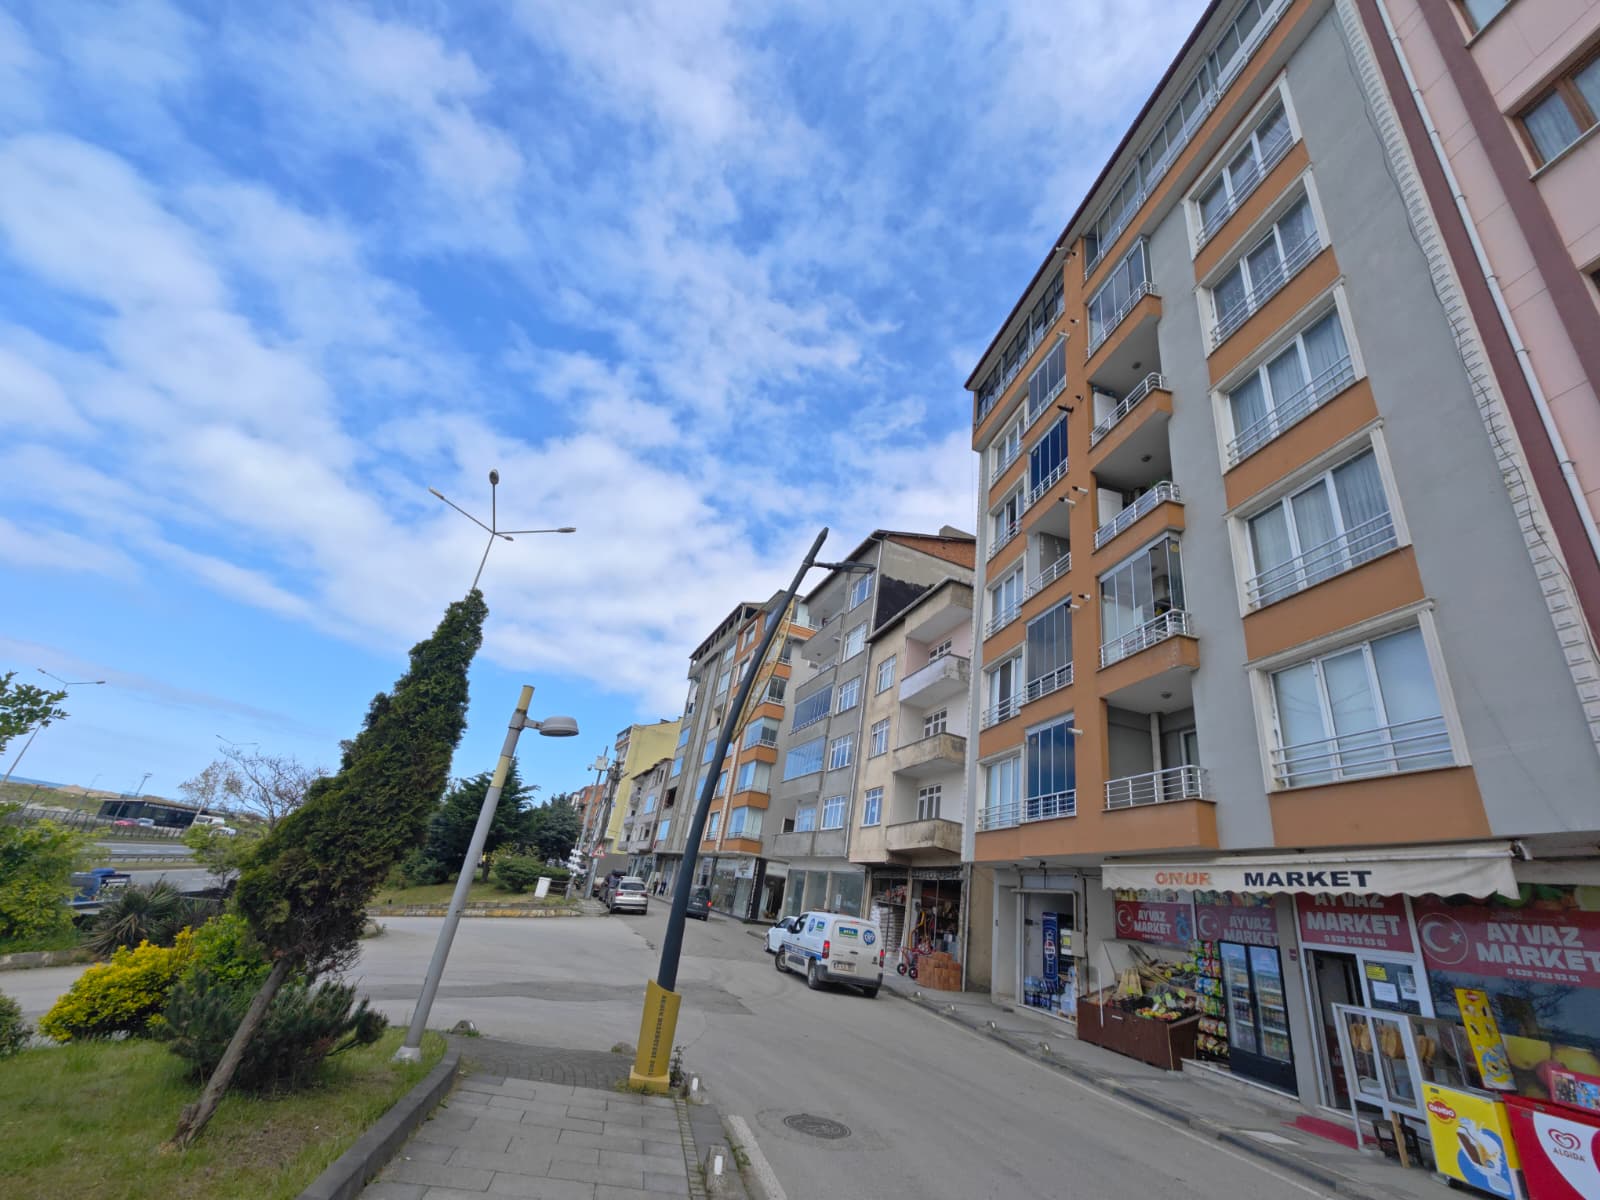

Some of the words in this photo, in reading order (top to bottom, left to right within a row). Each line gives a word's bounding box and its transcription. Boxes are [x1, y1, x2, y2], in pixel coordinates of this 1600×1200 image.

[1243, 870, 1372, 888] MARKET
[1315, 891, 1385, 909] AYVAZ
[1137, 910, 1167, 923] AYVAZ
[1229, 915, 1272, 931] AYVAZ
[1306, 911, 1400, 936] MARKET
[1133, 920, 1172, 935] MARKET
[1487, 922, 1585, 949] AYVAZ
[1223, 929, 1279, 948] MARKET
[1476, 942, 1600, 973] MARKET
[1553, 1146, 1586, 1163] ALGIDA
